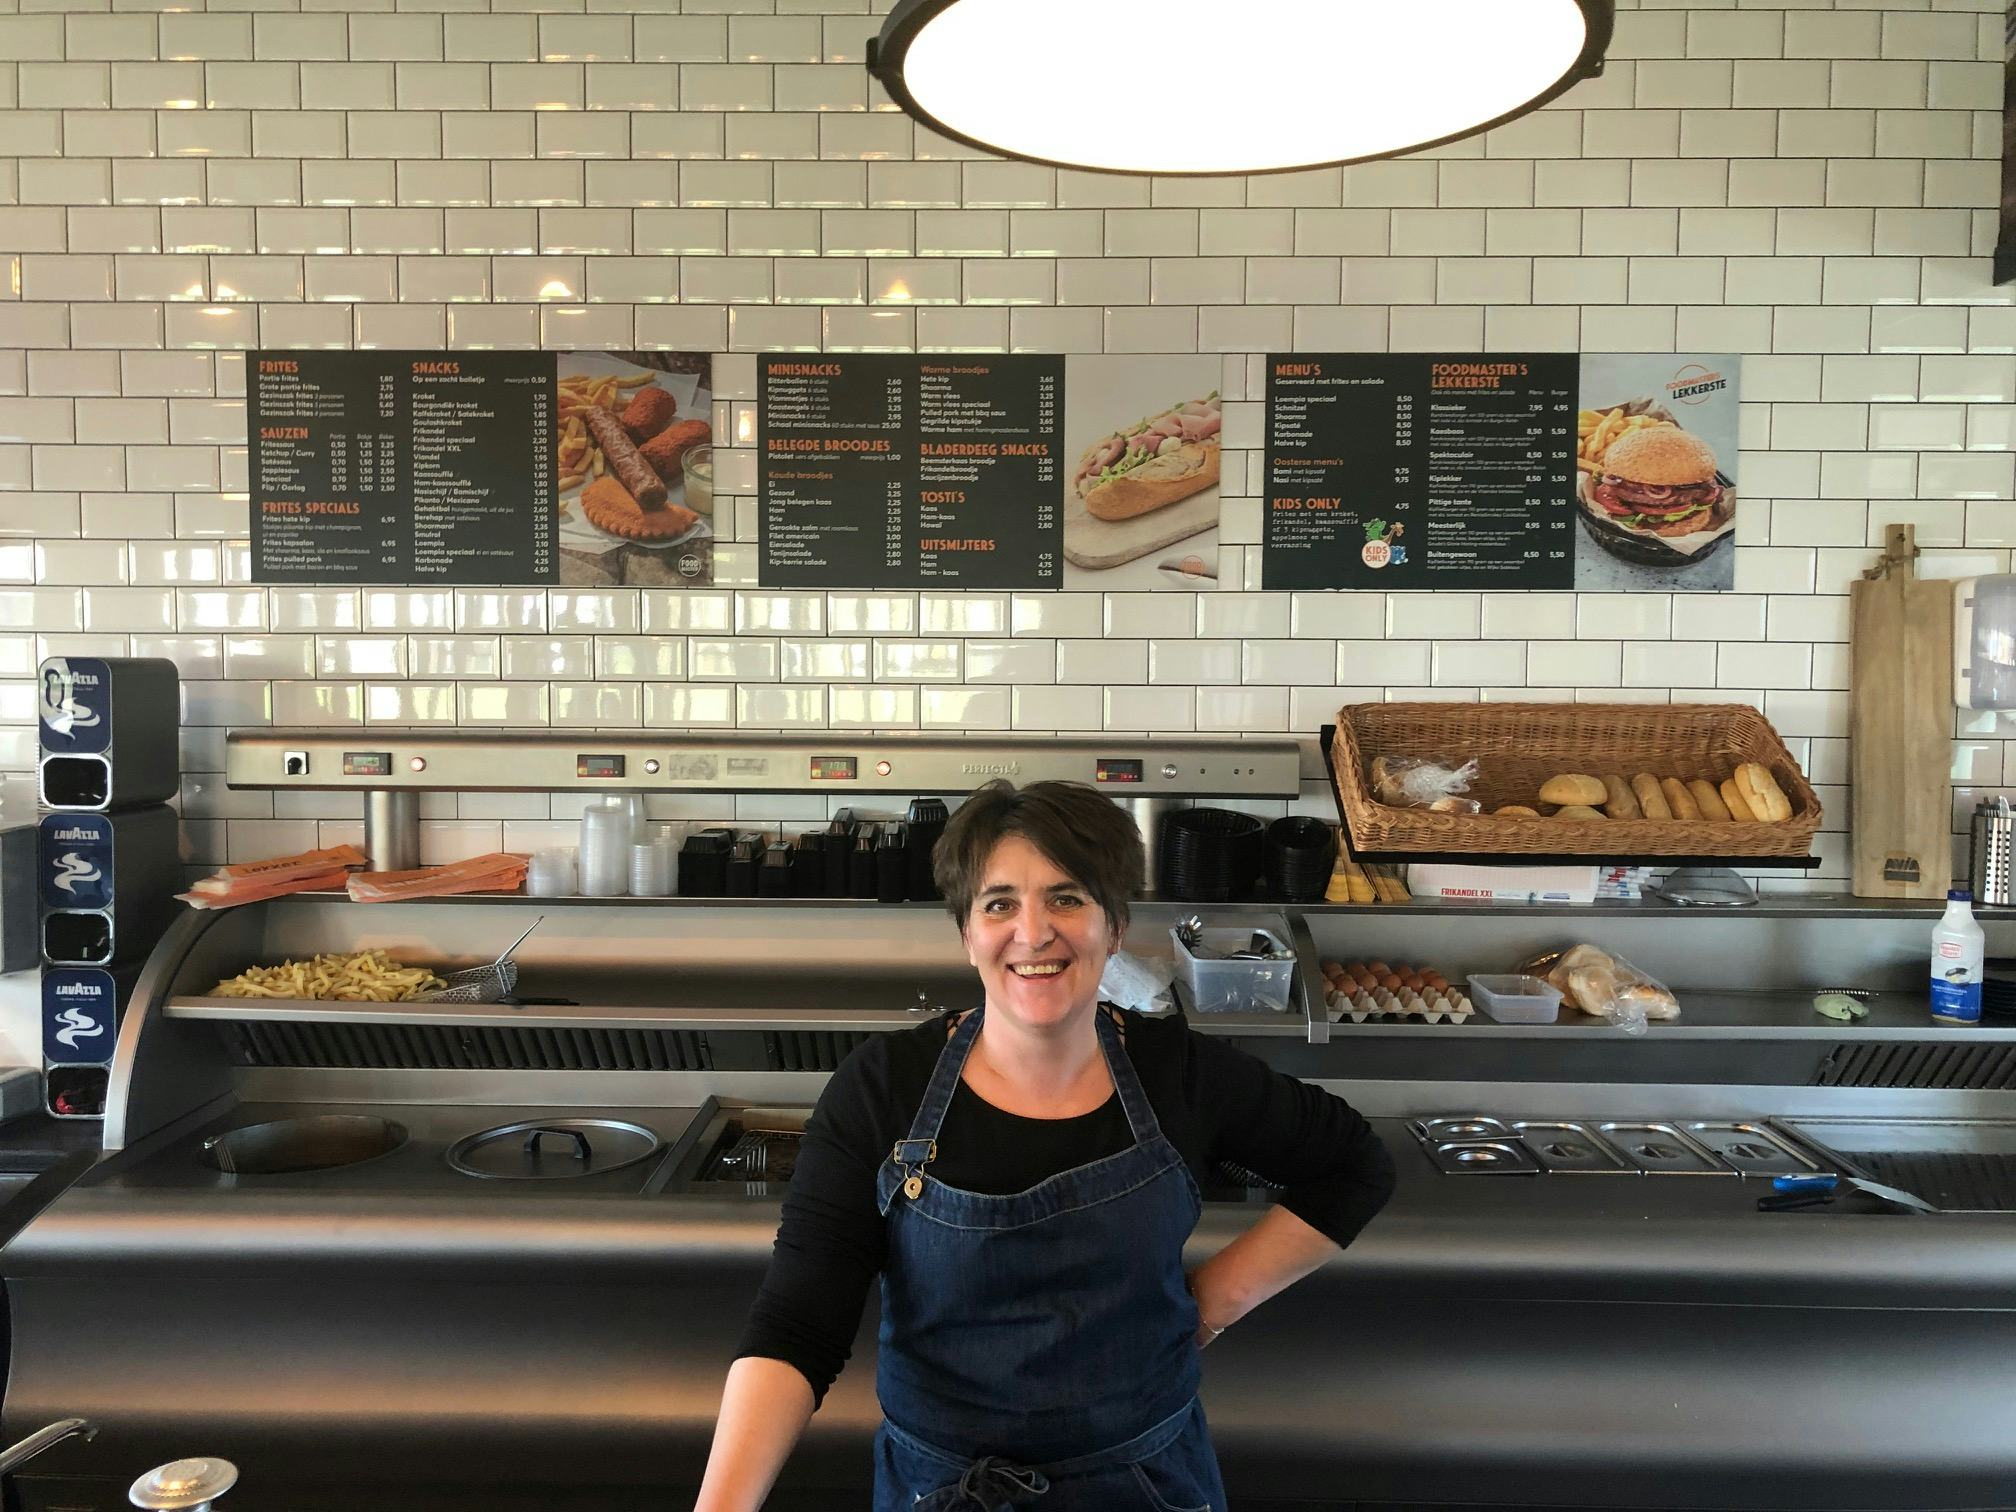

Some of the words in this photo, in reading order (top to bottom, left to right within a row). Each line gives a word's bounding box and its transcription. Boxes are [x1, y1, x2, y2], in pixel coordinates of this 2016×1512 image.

[259, 361, 299, 373] FRITES
[412, 362, 460, 374] SNACKS
[768, 364, 842, 376] MINISNACKS
[1276, 364, 1321, 376] MENU'S
[1432, 364, 1528, 376] FOODMASTER'S
[1432, 377, 1500, 388] LEKKERSTE
[1673, 379, 1727, 399] LEKKERSTE
[261, 428, 308, 439] SAUZEN
[768, 440, 820, 451] BELEGDE
[825, 440, 890, 452] BROODJES
[921, 444, 997, 455] BLADERDEEG
[1001, 444, 1048, 455] SNACKS
[1274, 458, 1311, 466] Oosterse
[797, 472, 833, 480] broodjes
[921, 491, 965, 503] TOSTI'S
[262, 502, 302, 513] FRITES
[306, 503, 360, 514] SPECIALS
[1273, 498, 1302, 509] KIDS
[1306, 498, 1341, 509] ONLY
[921, 540, 996, 551] UITSMIJTERS
[54, 671, 99, 685] LAVAZZA
[54, 827, 100, 840] LAVAZZA
[1441, 888, 1478, 897] FRIKANDEL
[1480, 890, 1493, 898] XXL
[56, 982, 101, 995] LAVAZZA
